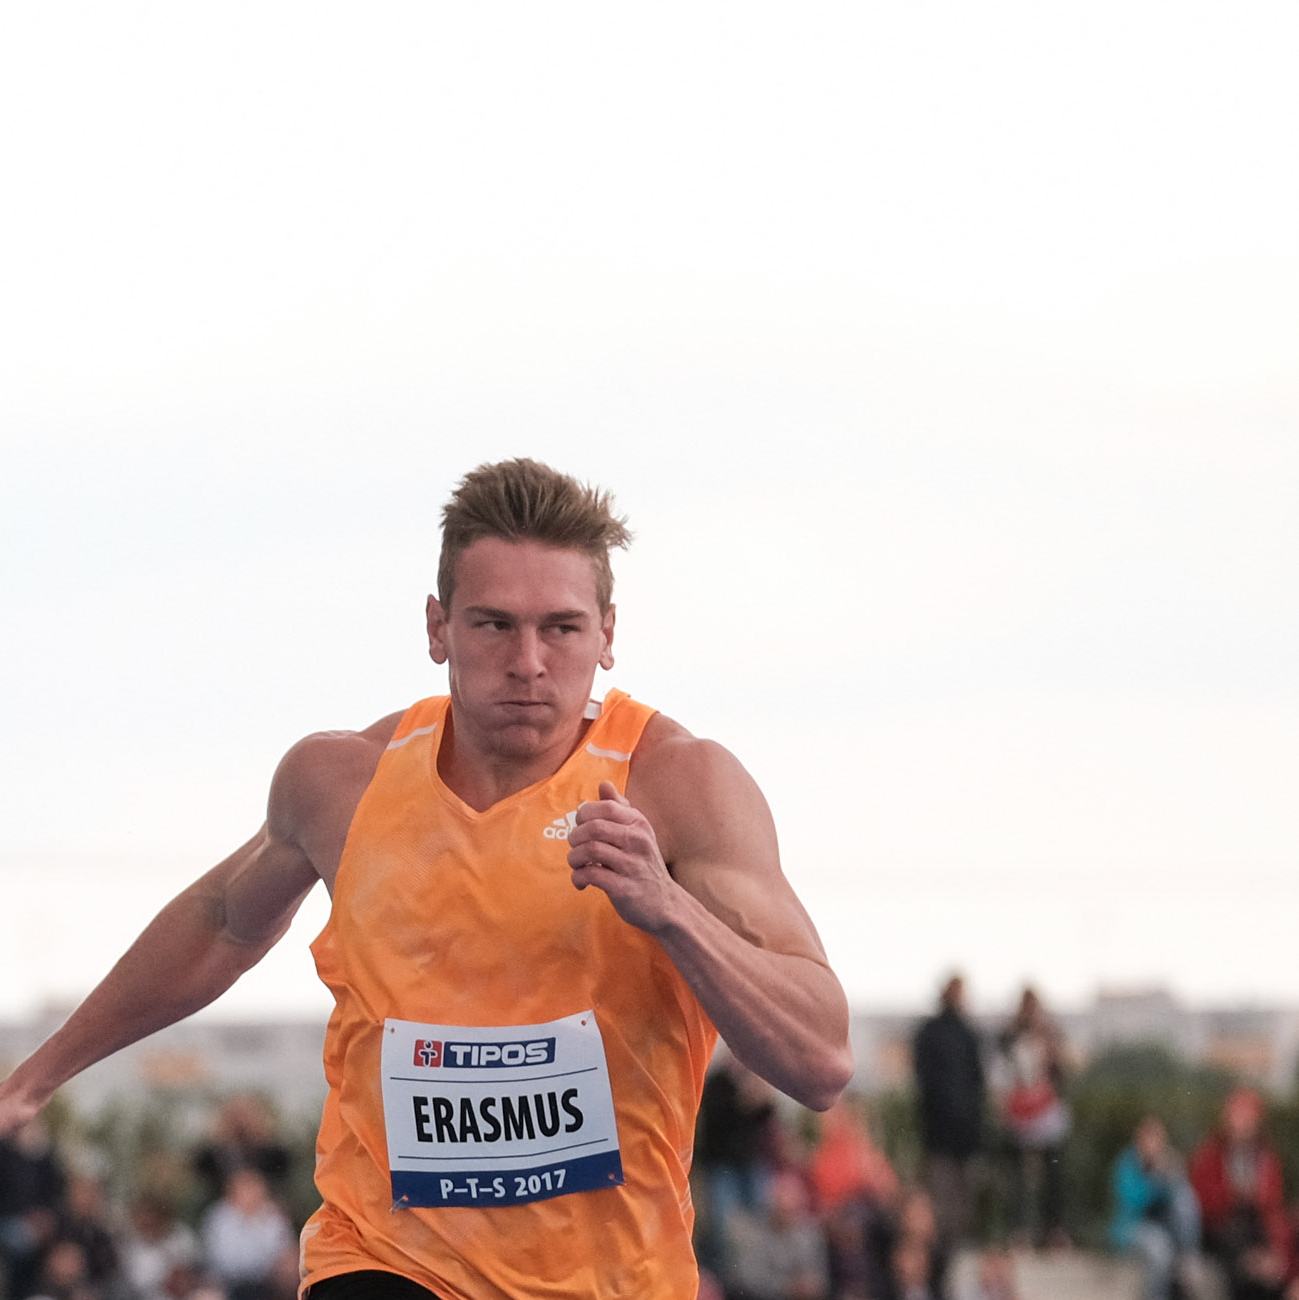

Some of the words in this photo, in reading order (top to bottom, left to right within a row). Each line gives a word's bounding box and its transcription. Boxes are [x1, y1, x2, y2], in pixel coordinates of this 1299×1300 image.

[450, 1042, 548, 1066] TIPOS
[412, 1088, 584, 1143] ERASMUS
[440, 1178, 505, 1199] P-T-S
[515, 1169, 566, 1197] 2017
